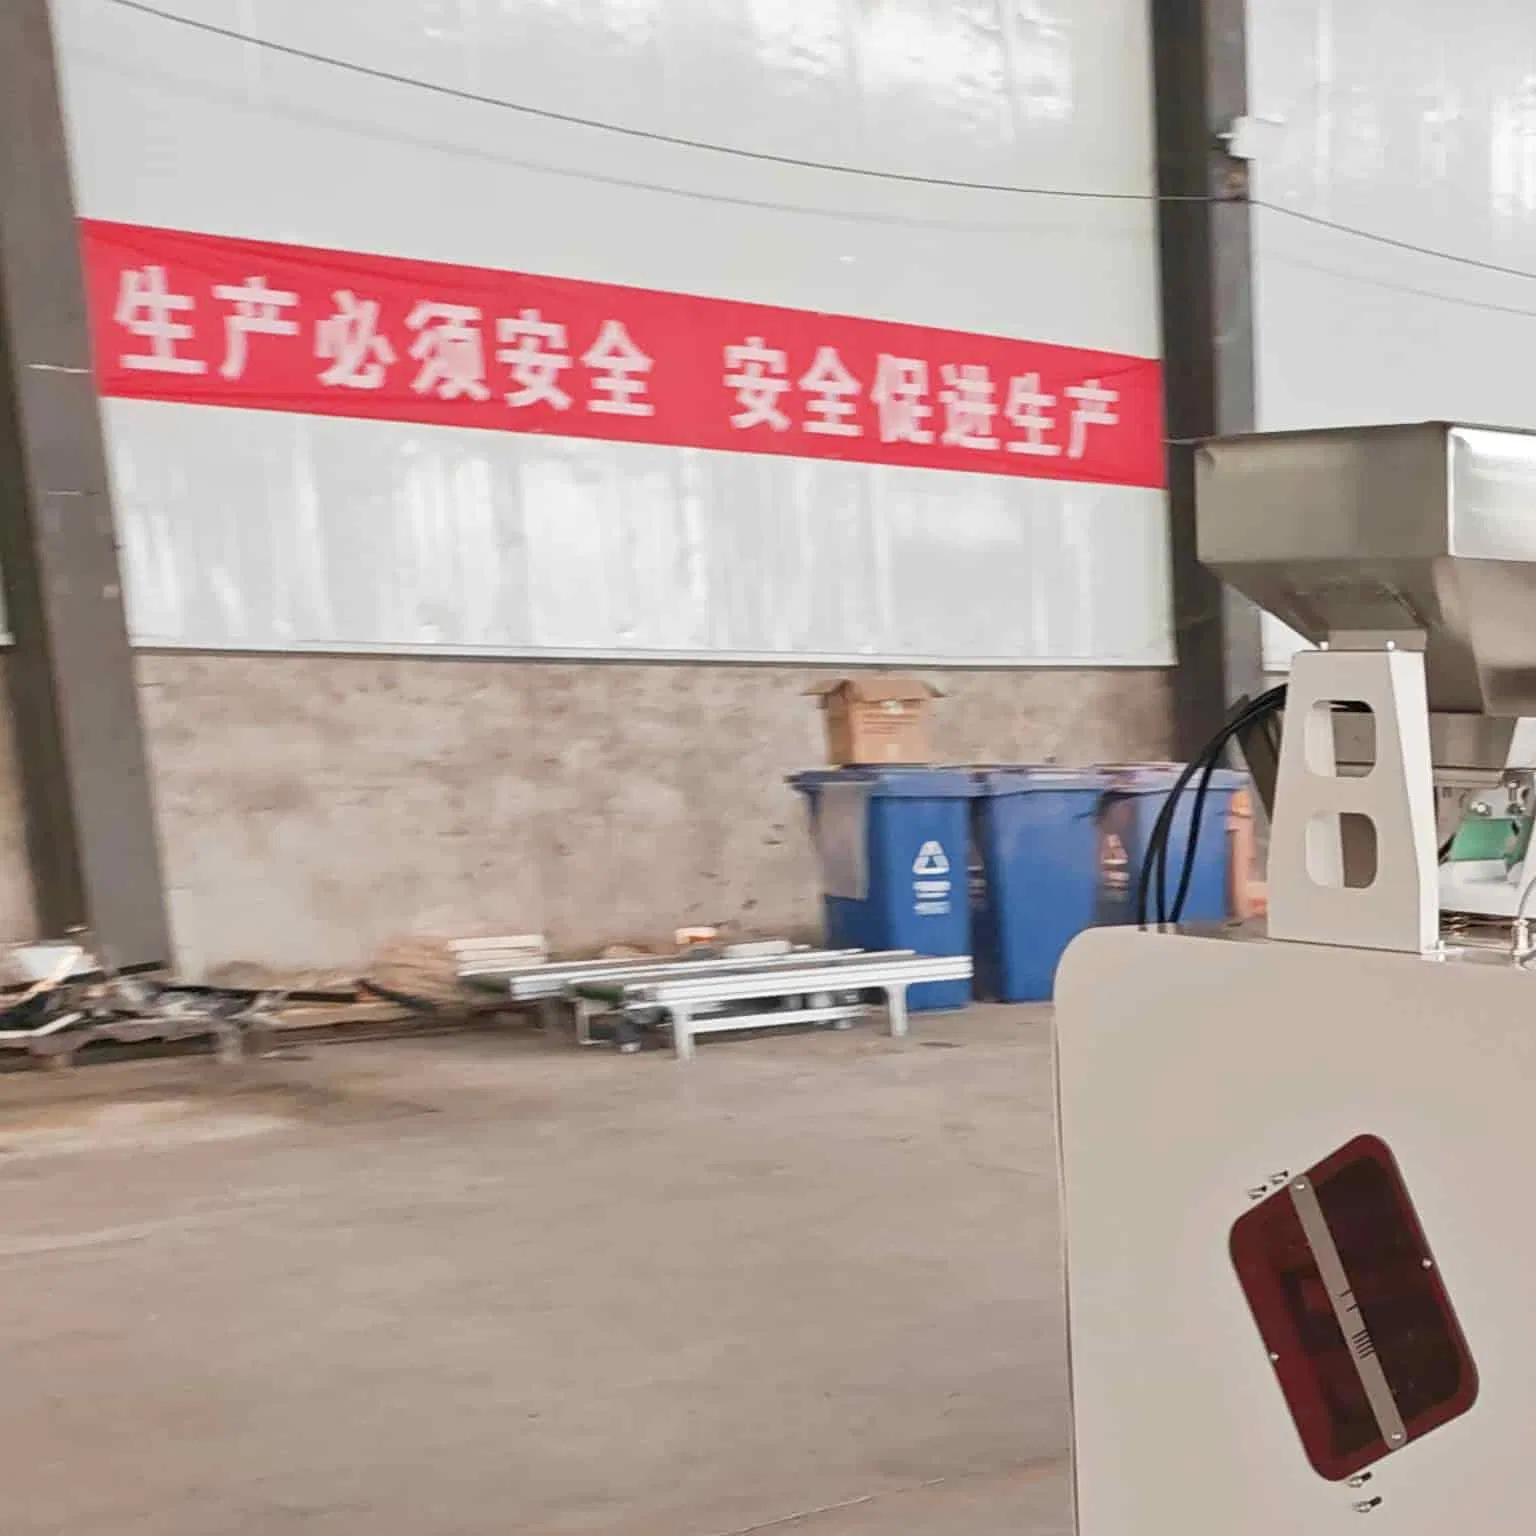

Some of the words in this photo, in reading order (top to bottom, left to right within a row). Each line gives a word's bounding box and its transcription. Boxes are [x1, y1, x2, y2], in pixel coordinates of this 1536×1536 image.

[114, 265, 654, 418] 生产必须安全
[723, 337, 1120, 460] 安全促进生产
